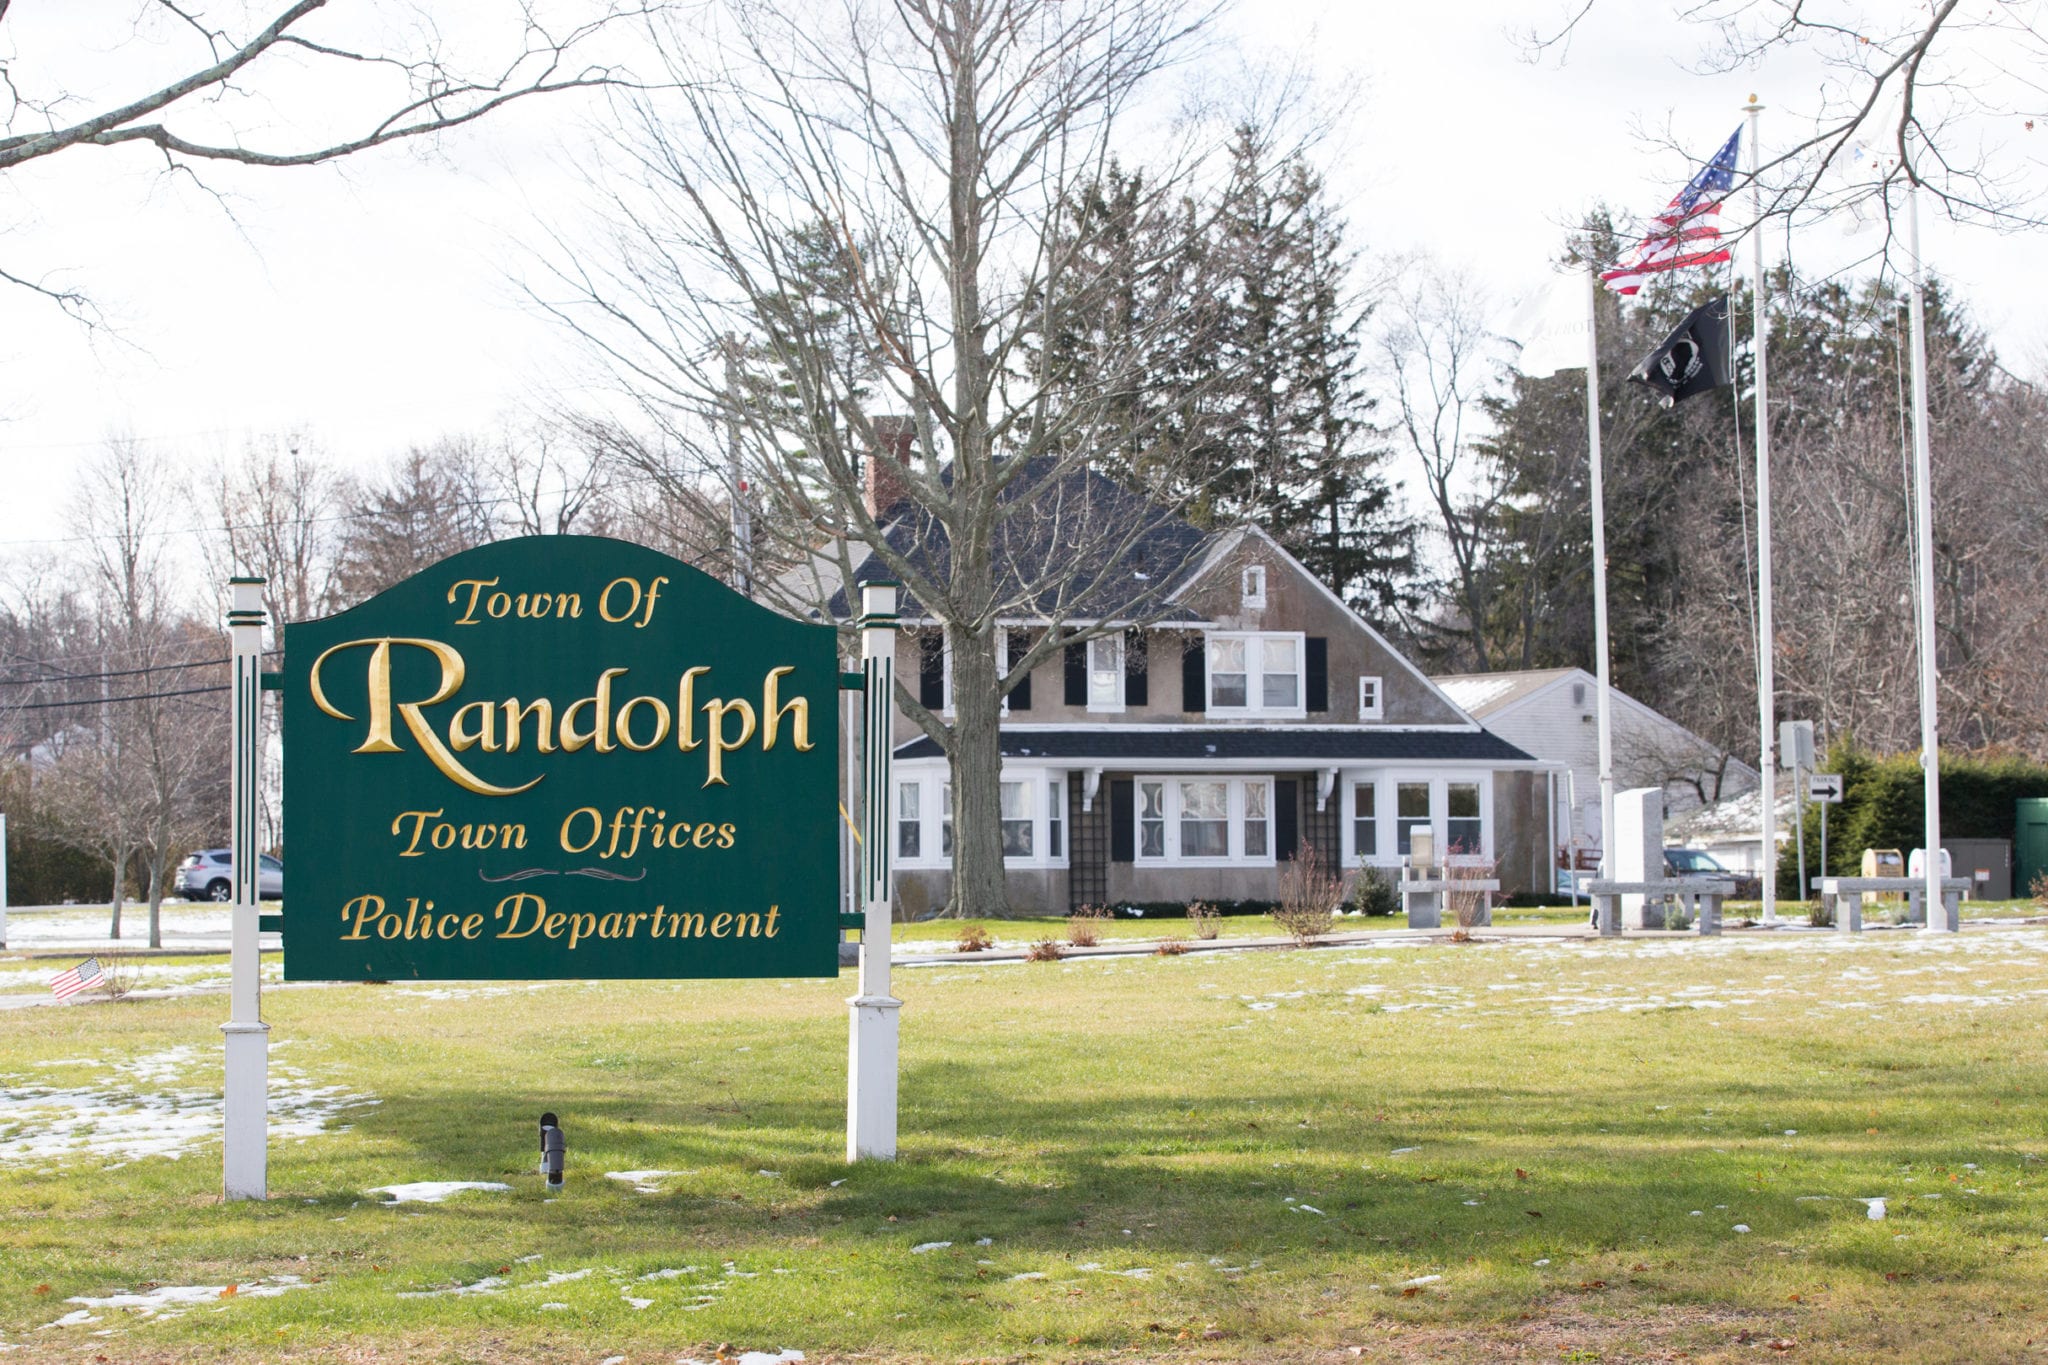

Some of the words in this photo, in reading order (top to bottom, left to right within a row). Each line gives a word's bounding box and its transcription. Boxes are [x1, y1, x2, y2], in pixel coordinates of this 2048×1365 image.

[448, 577, 582, 624] Town
[599, 577, 668, 627] Of
[309, 637, 816, 796] Randolph
[391, 808, 527, 856] Town
[560, 807, 736, 858] Offices
[340, 894, 484, 940] Police
[495, 892, 780, 949] Department
